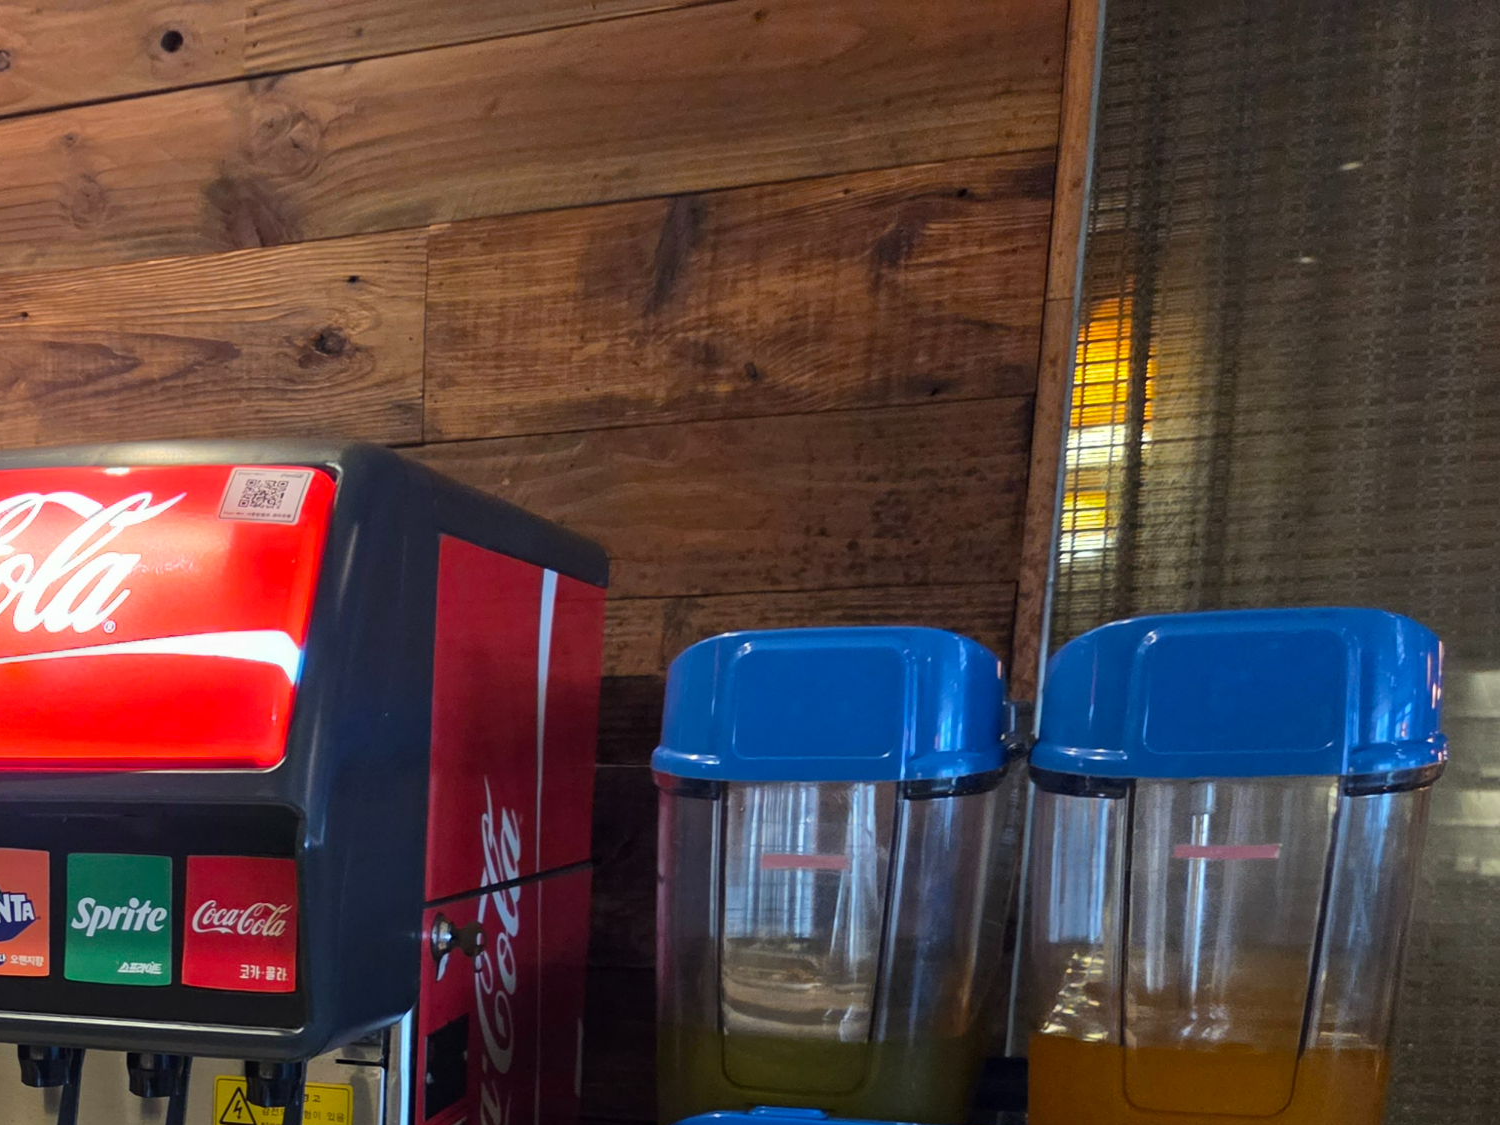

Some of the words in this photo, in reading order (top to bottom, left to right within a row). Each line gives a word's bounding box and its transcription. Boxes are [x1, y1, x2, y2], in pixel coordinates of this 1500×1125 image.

[71, 897, 168, 937] Sprite
[192, 900, 294, 937] Coca-Cola
[117, 961, 162, 974] 스프라이트
